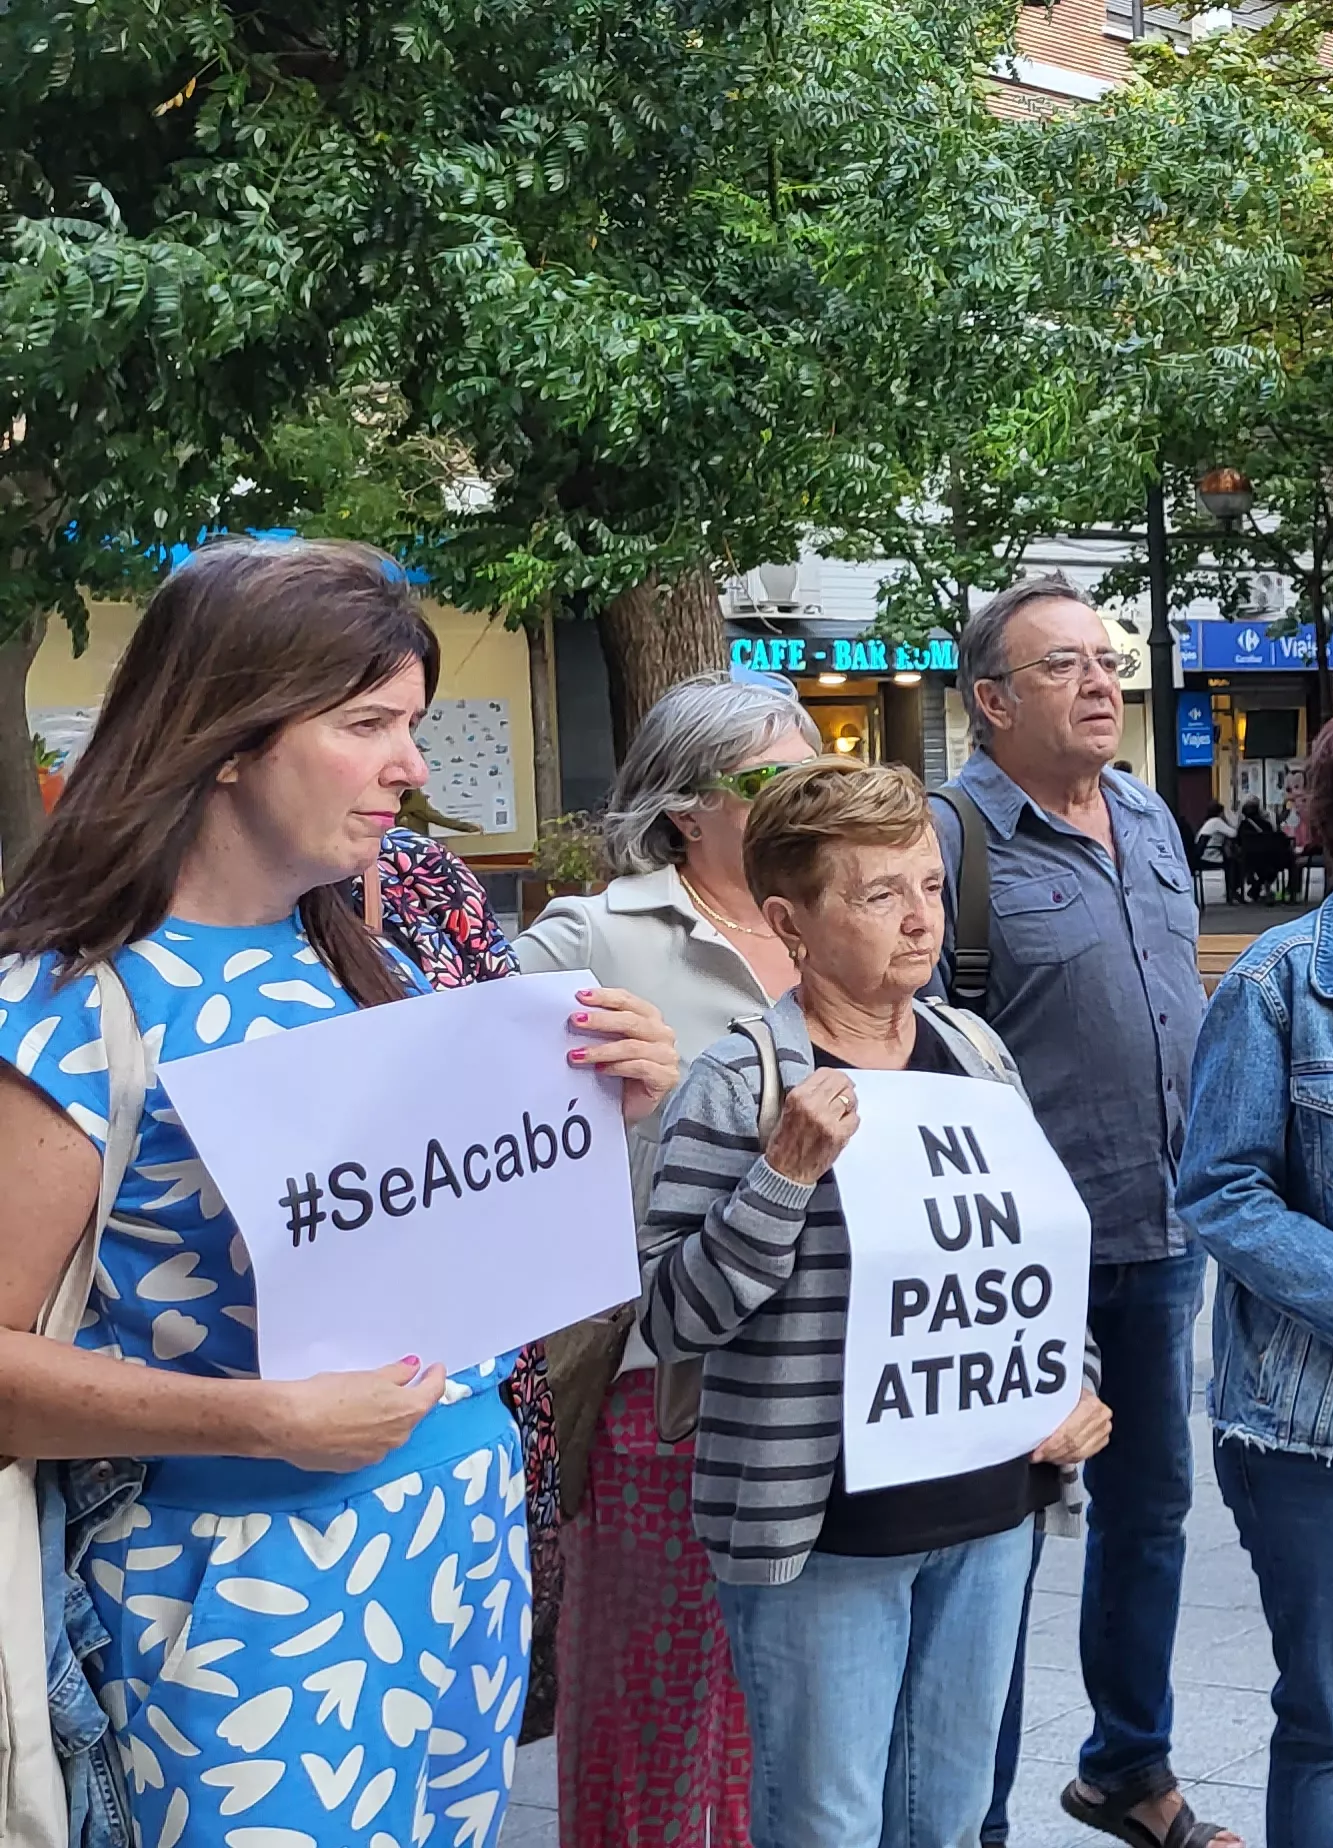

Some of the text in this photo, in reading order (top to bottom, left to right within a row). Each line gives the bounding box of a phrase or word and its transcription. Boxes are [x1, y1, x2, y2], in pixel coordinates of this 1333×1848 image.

[731, 638, 807, 671] CAFE
[833, 638, 889, 671] BAR
[1280, 633, 1332, 658] Viaj
[278, 1097, 592, 1248] #SeAcabó
[917, 1125, 991, 1177] NI
[922, 1191, 1022, 1252] UN
[889, 1264, 1053, 1338] PASO
[865, 1327, 1068, 1425] ATRÁS
